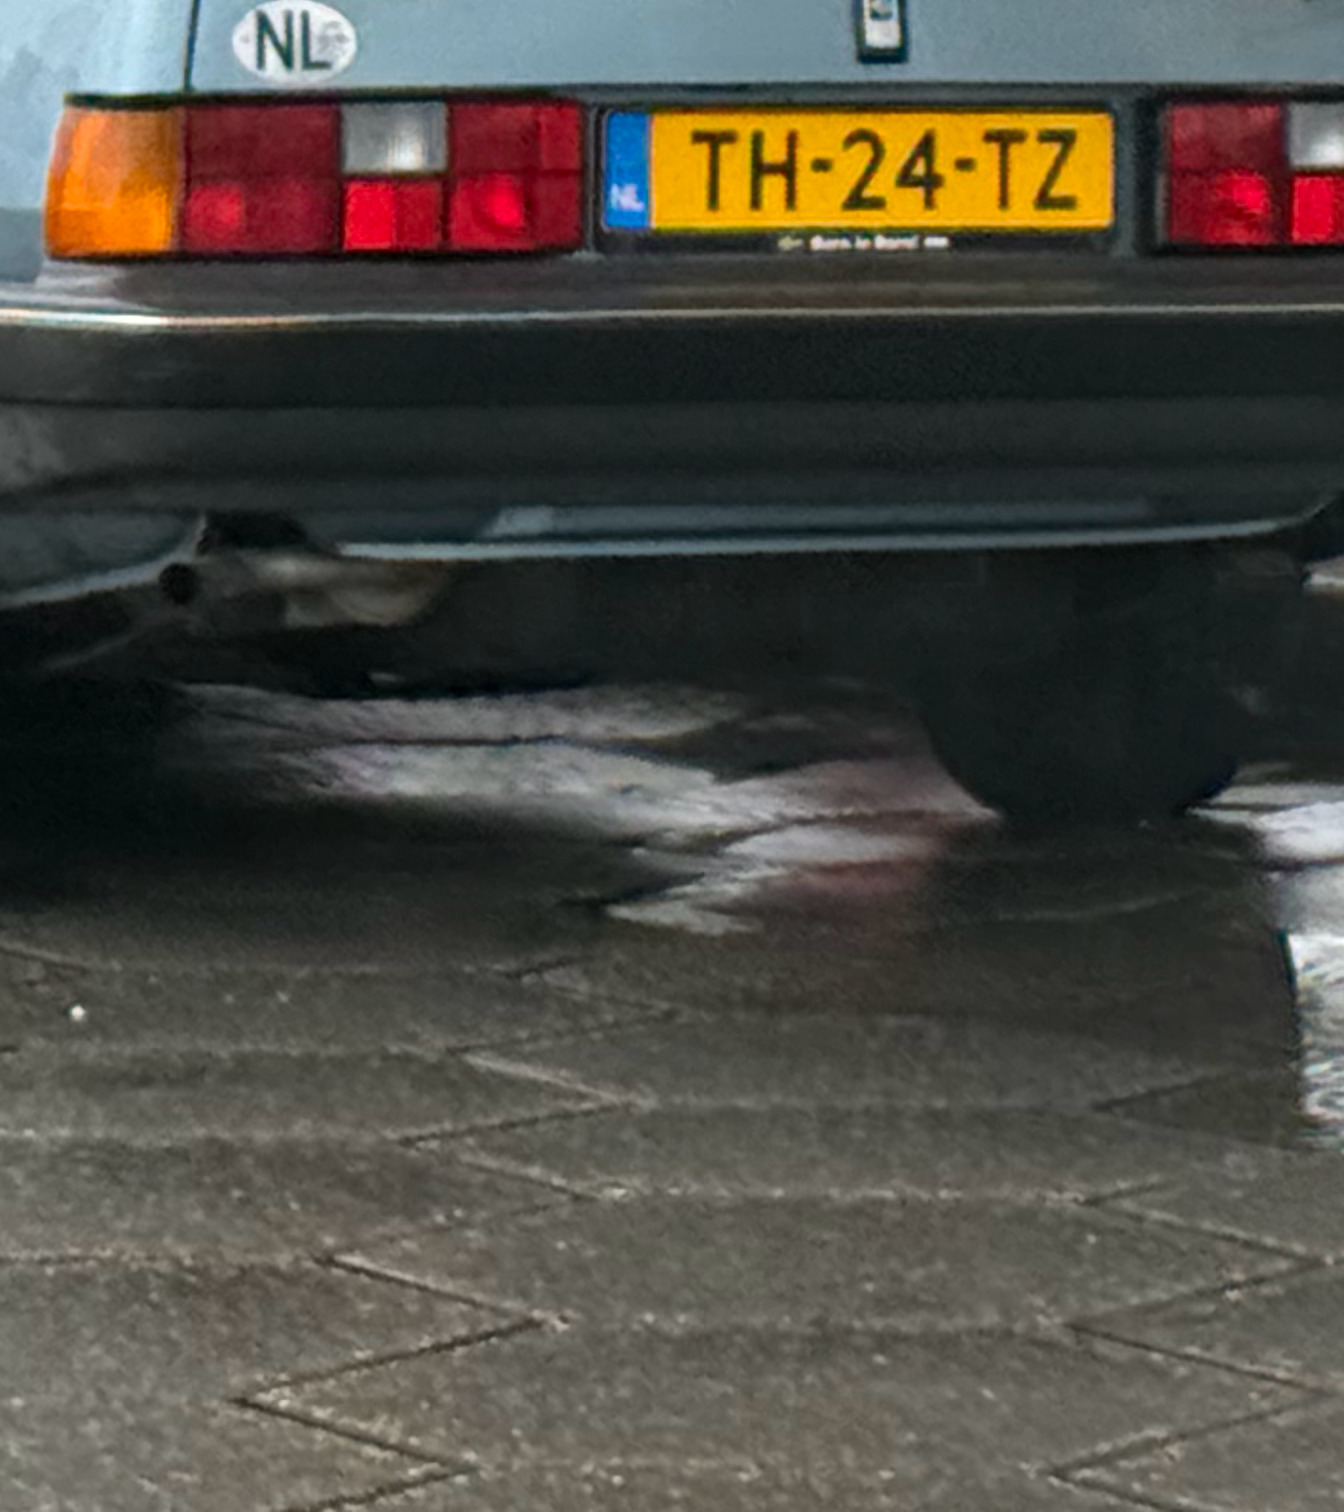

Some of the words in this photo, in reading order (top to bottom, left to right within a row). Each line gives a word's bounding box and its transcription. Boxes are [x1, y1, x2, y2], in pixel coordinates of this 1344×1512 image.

[255, 9, 333, 72] NL
[610, 183, 645, 213] NL
[690, 128, 1078, 212] TH-24-TZ
